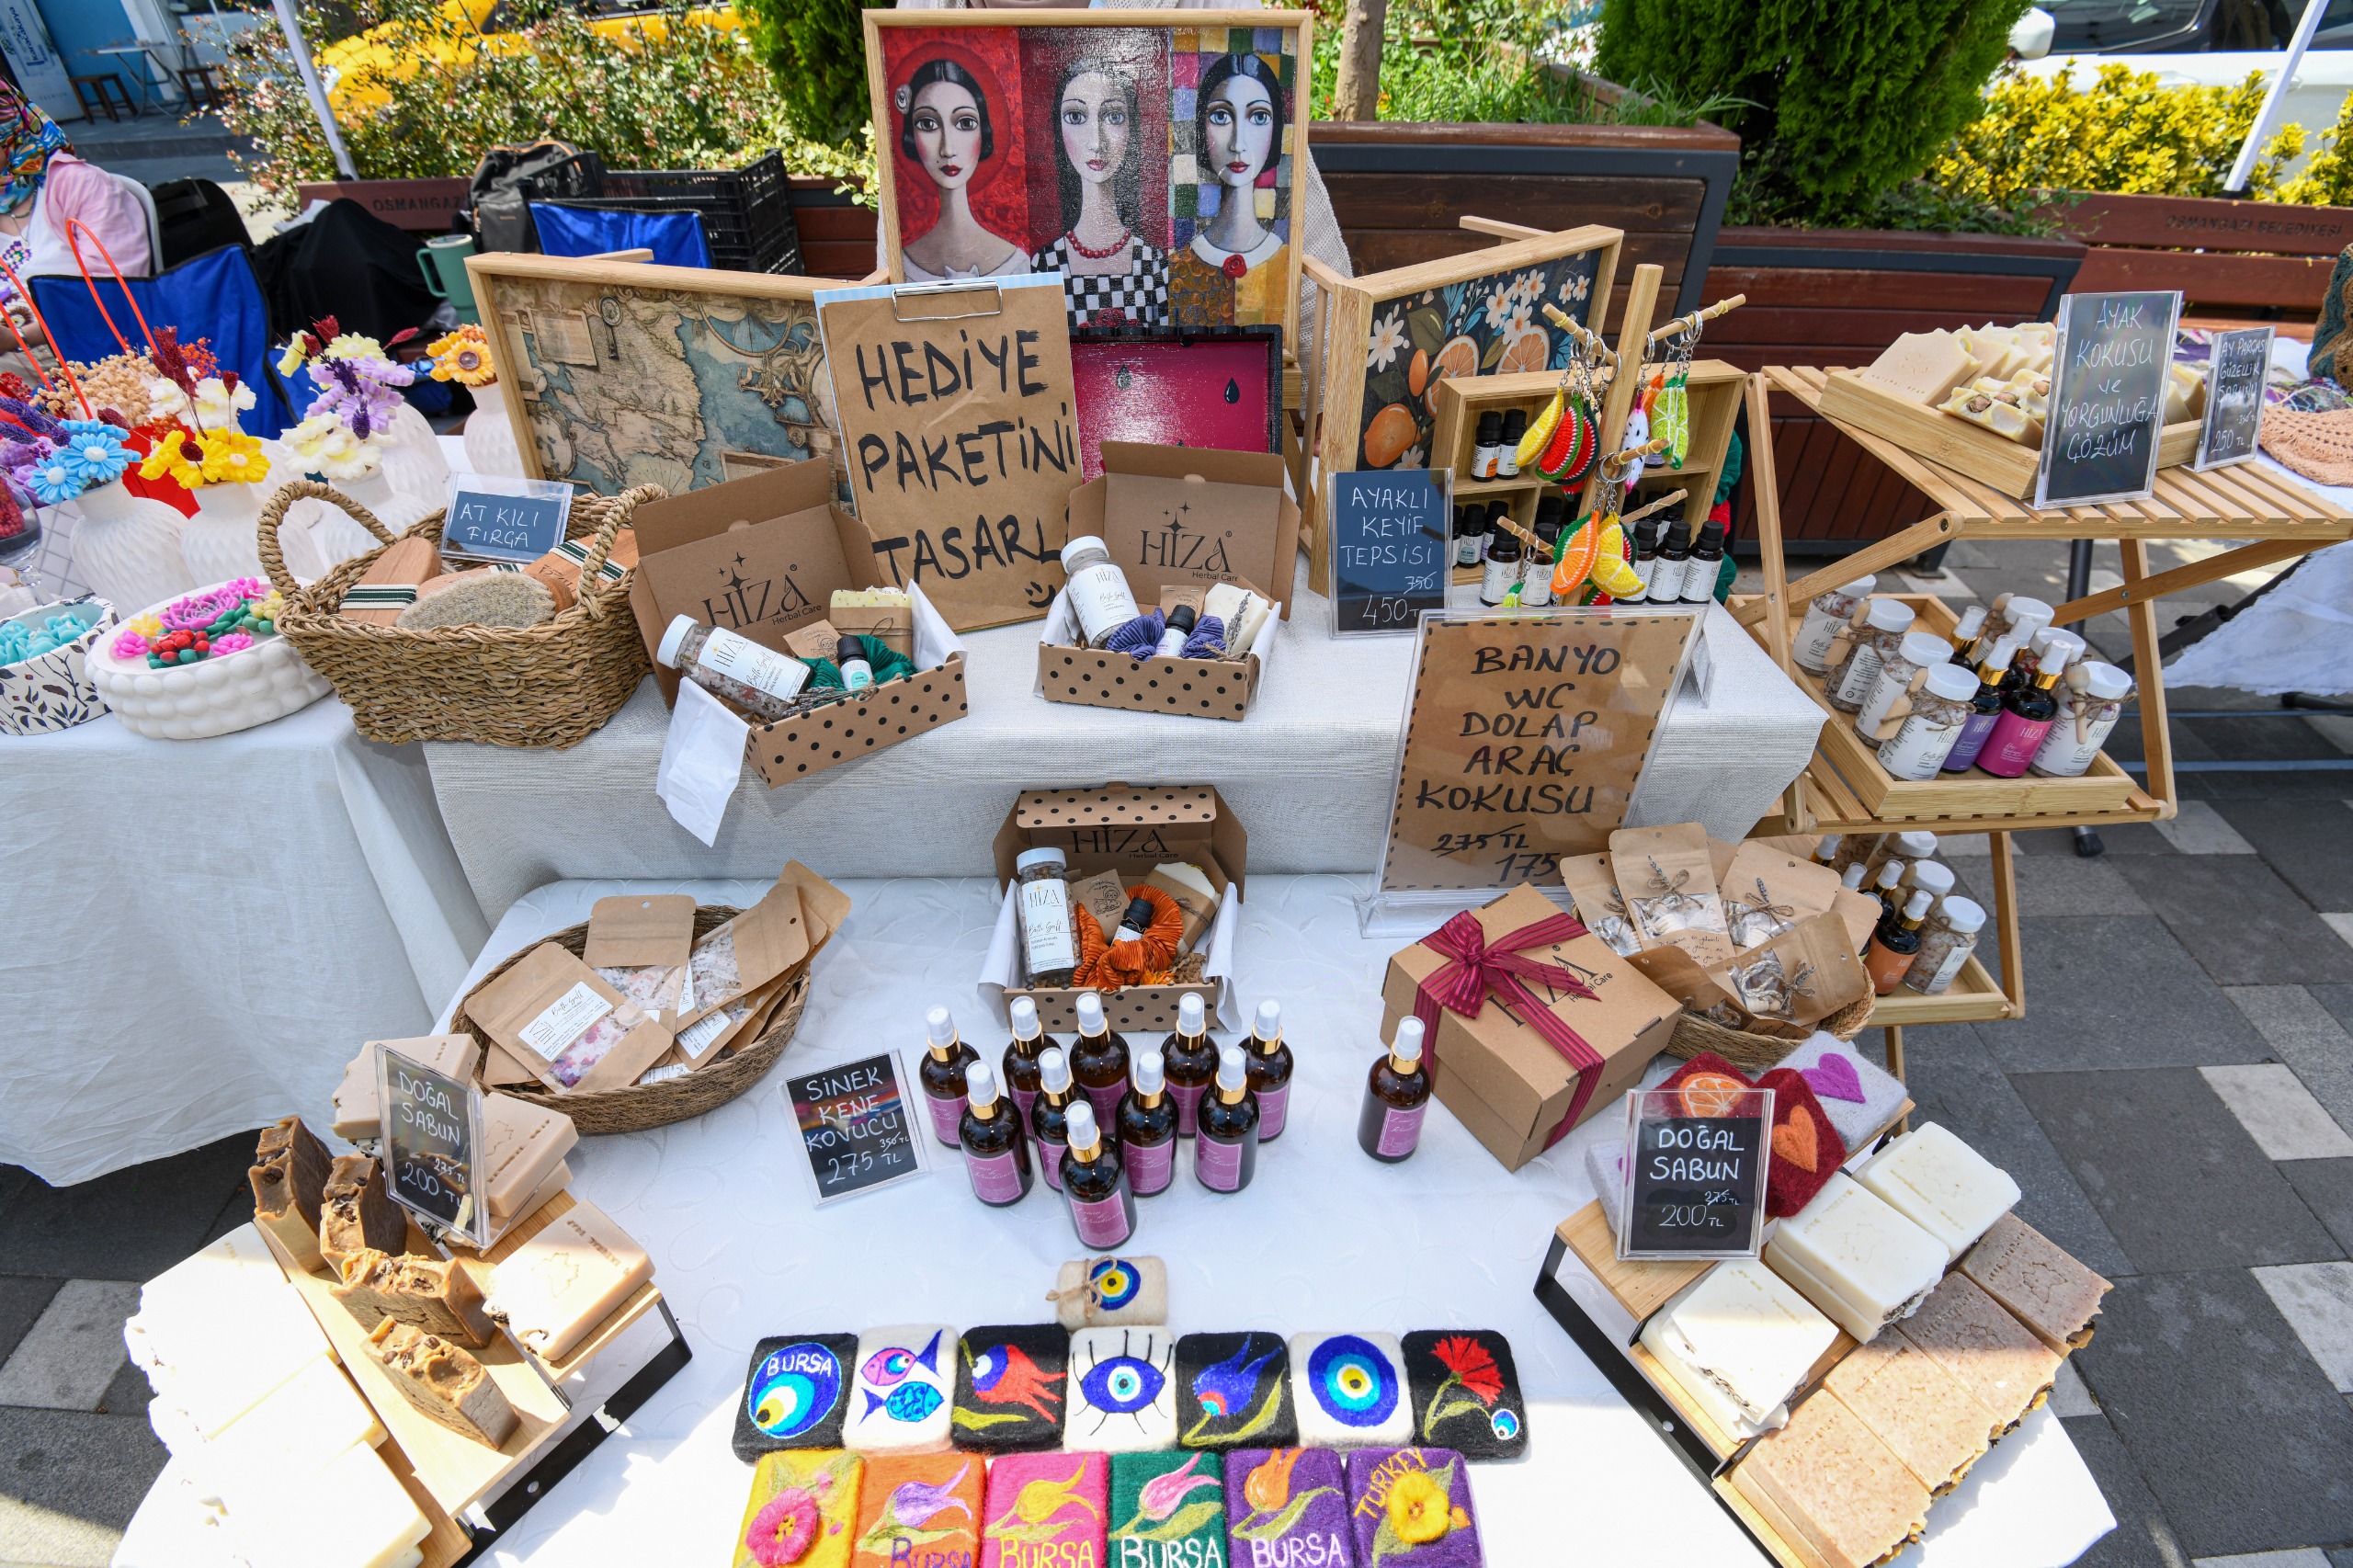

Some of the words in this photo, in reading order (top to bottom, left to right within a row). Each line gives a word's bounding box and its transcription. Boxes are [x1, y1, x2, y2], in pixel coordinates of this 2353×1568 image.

[373, 197, 465, 211] OSMANGAZ
[2095, 300, 2143, 331] AYAK
[2076, 338, 2153, 369] KOKUSU
[2221, 341, 2235, 358] AY
[2098, 378, 2121, 393] ve
[2062, 393, 2160, 428] YORGUNLUĞA
[2067, 429, 2137, 463] ÇÖZÜM
[2211, 429, 2234, 453] 250
[1352, 487, 1427, 510] AYAKLI
[460, 503, 486, 522] AT
[496, 507, 539, 527] KILI
[1362, 513, 1425, 538] KEYİF
[872, 508, 1069, 588] TASARL
[1192, 570, 1219, 581] Herbal
[771, 610, 801, 626] Herbal
[801, 604, 822, 619] Care
[1362, 595, 1408, 626] 450
[1824, 621, 1841, 634] HIZ
[1471, 643, 1620, 675] BANYO
[1505, 683, 1574, 710] WC
[1460, 710, 1597, 737] DOLAP
[1463, 744, 1580, 777] ARAÇ
[1415, 779, 1595, 813] KOKUSU
[1501, 834, 1529, 848] TL
[1495, 852, 1562, 881] 175
[1569, 983, 1597, 1003] Heal
[1594, 972, 1613, 986] Care
[399, 1071, 459, 1119] DOĞAL
[819, 1095, 880, 1125] KENE
[401, 1103, 460, 1147] SABUN
[806, 1112, 898, 1153] KOVUCU
[1657, 1125, 1745, 1151] DOĞAL
[401, 1163, 439, 1196] 200
[827, 1151, 873, 1184] 275
[881, 1153, 903, 1165] TL
[1649, 1156, 1739, 1181] SABUN
[1705, 1189, 1730, 1206] 275
[1728, 1198, 1740, 1206] TL
[1658, 1204, 1707, 1227] 200
[1708, 1217, 1724, 1227] TL
[767, 1353, 833, 1378] BURSA
[1354, 1447, 1427, 1518] TURKEY
[999, 1536, 1095, 1568] BURSA
[1120, 1534, 1222, 1568] BURSA
[1251, 1532, 1347, 1568] BURSA
